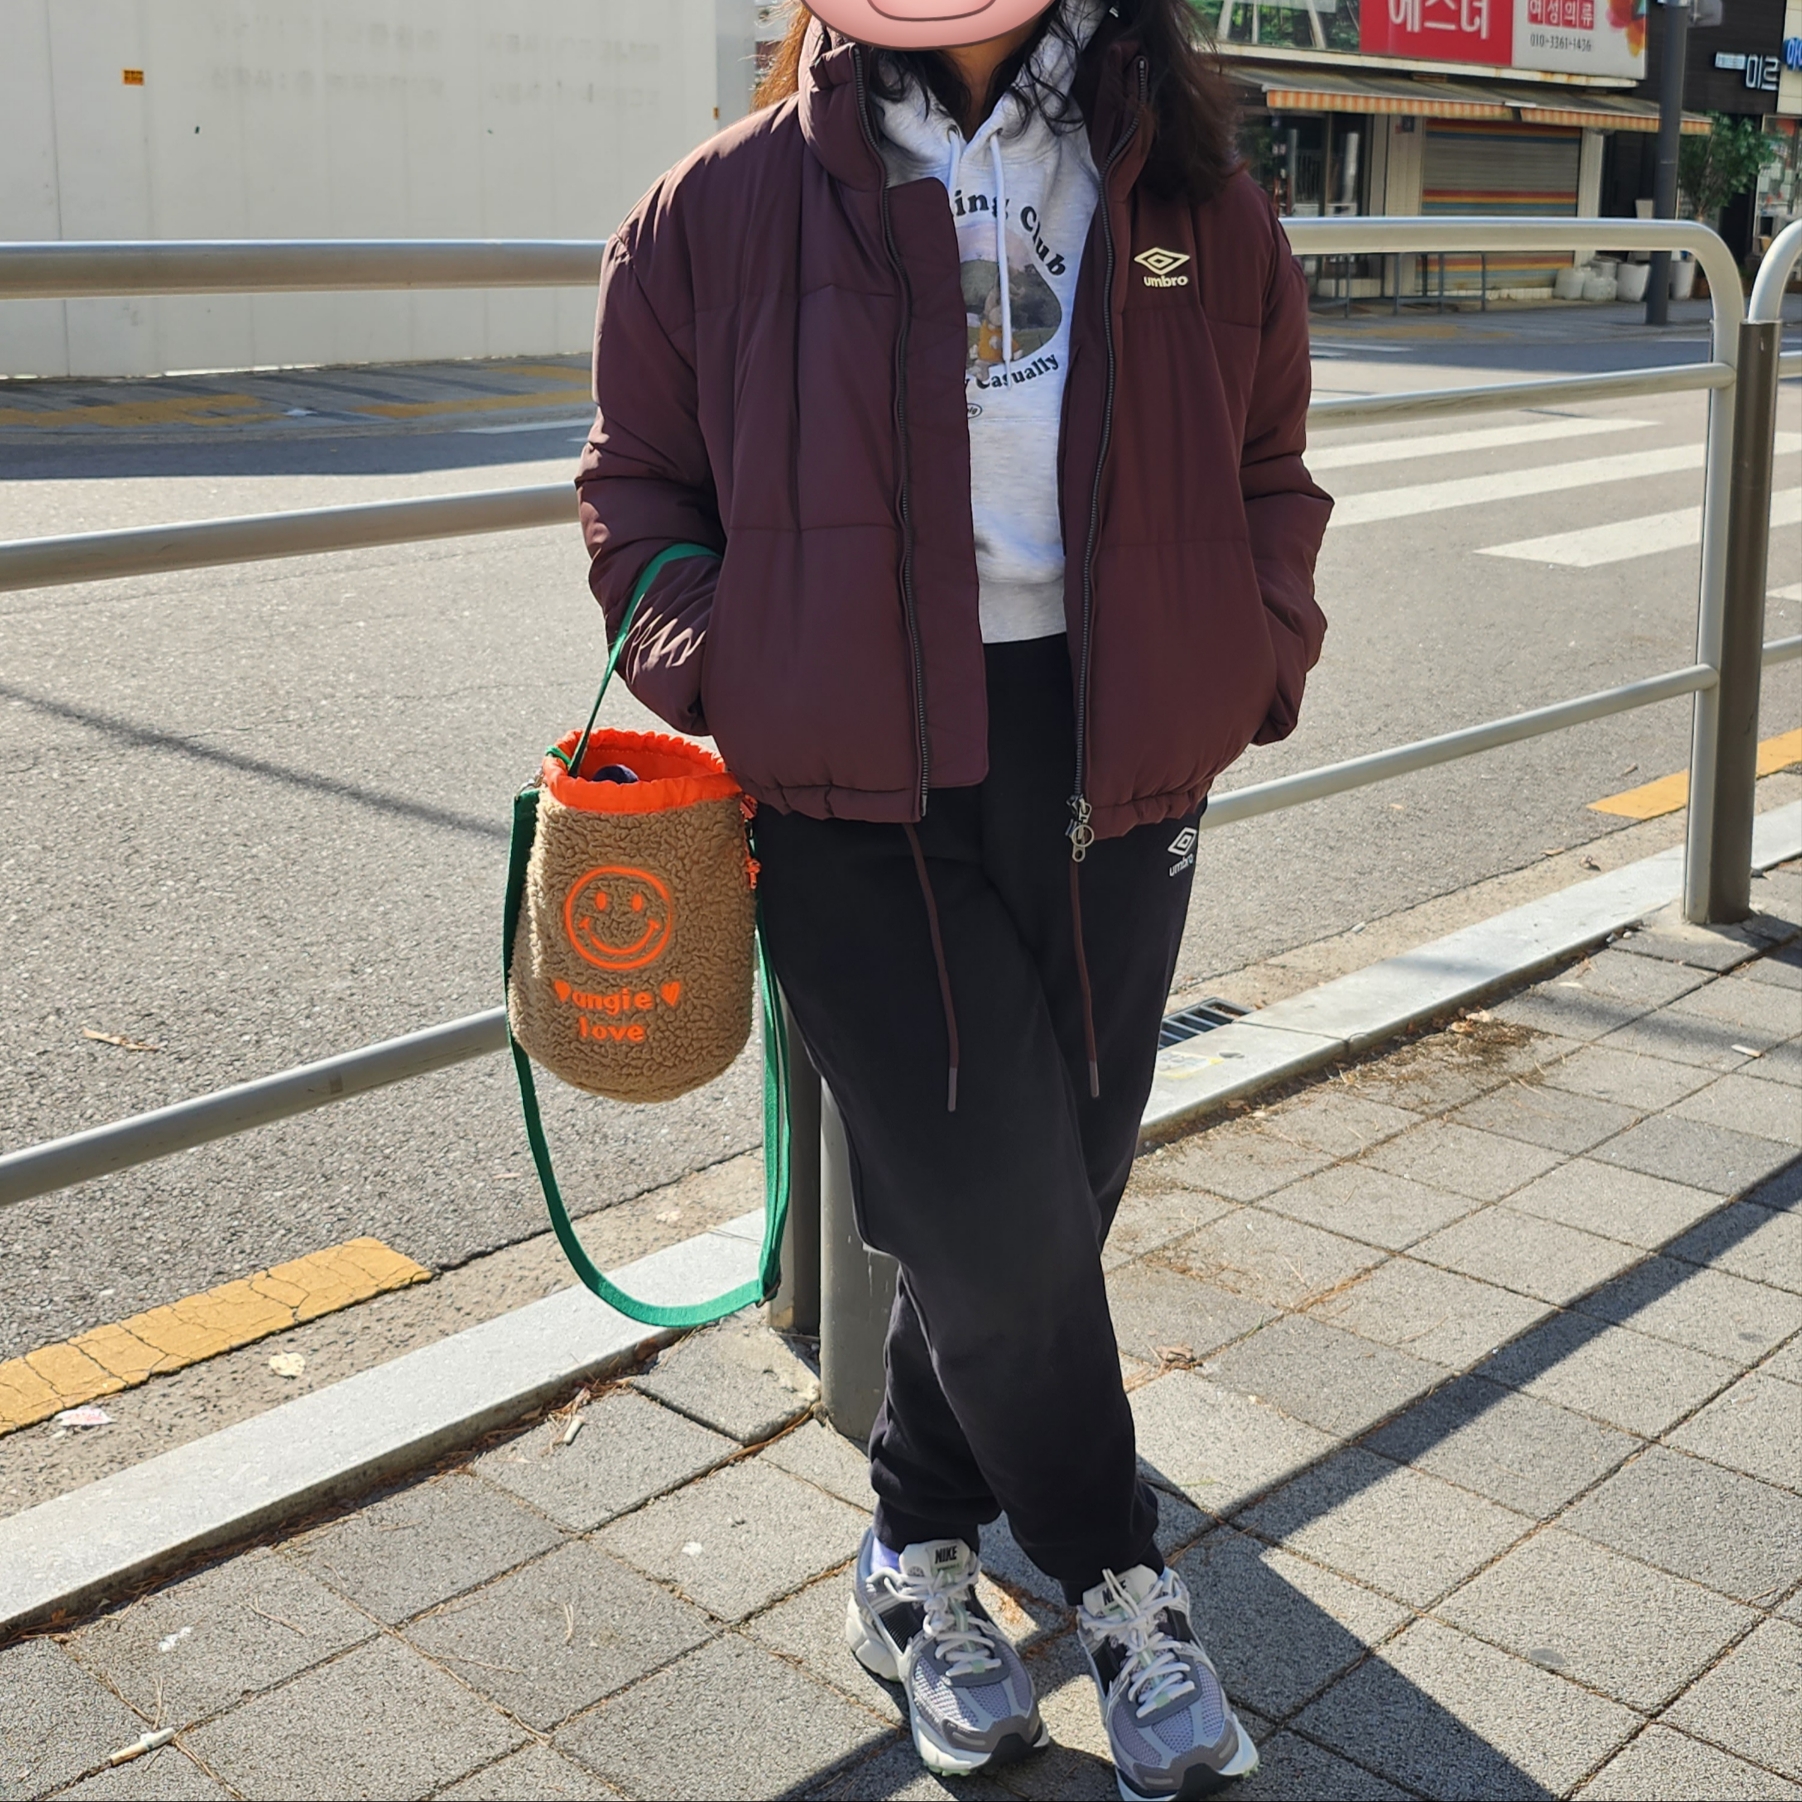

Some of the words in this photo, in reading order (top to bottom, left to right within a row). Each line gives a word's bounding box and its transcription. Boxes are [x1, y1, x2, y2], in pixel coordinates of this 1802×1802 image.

[1529, 0, 1593, 27] 여성의류
[1020, 206, 1066, 276] Club
[1143, 275, 1188, 287] umbro
[572, 987, 653, 1016] angie
[579, 1016, 645, 1041] love
[935, 1545, 957, 1564] NIKE
